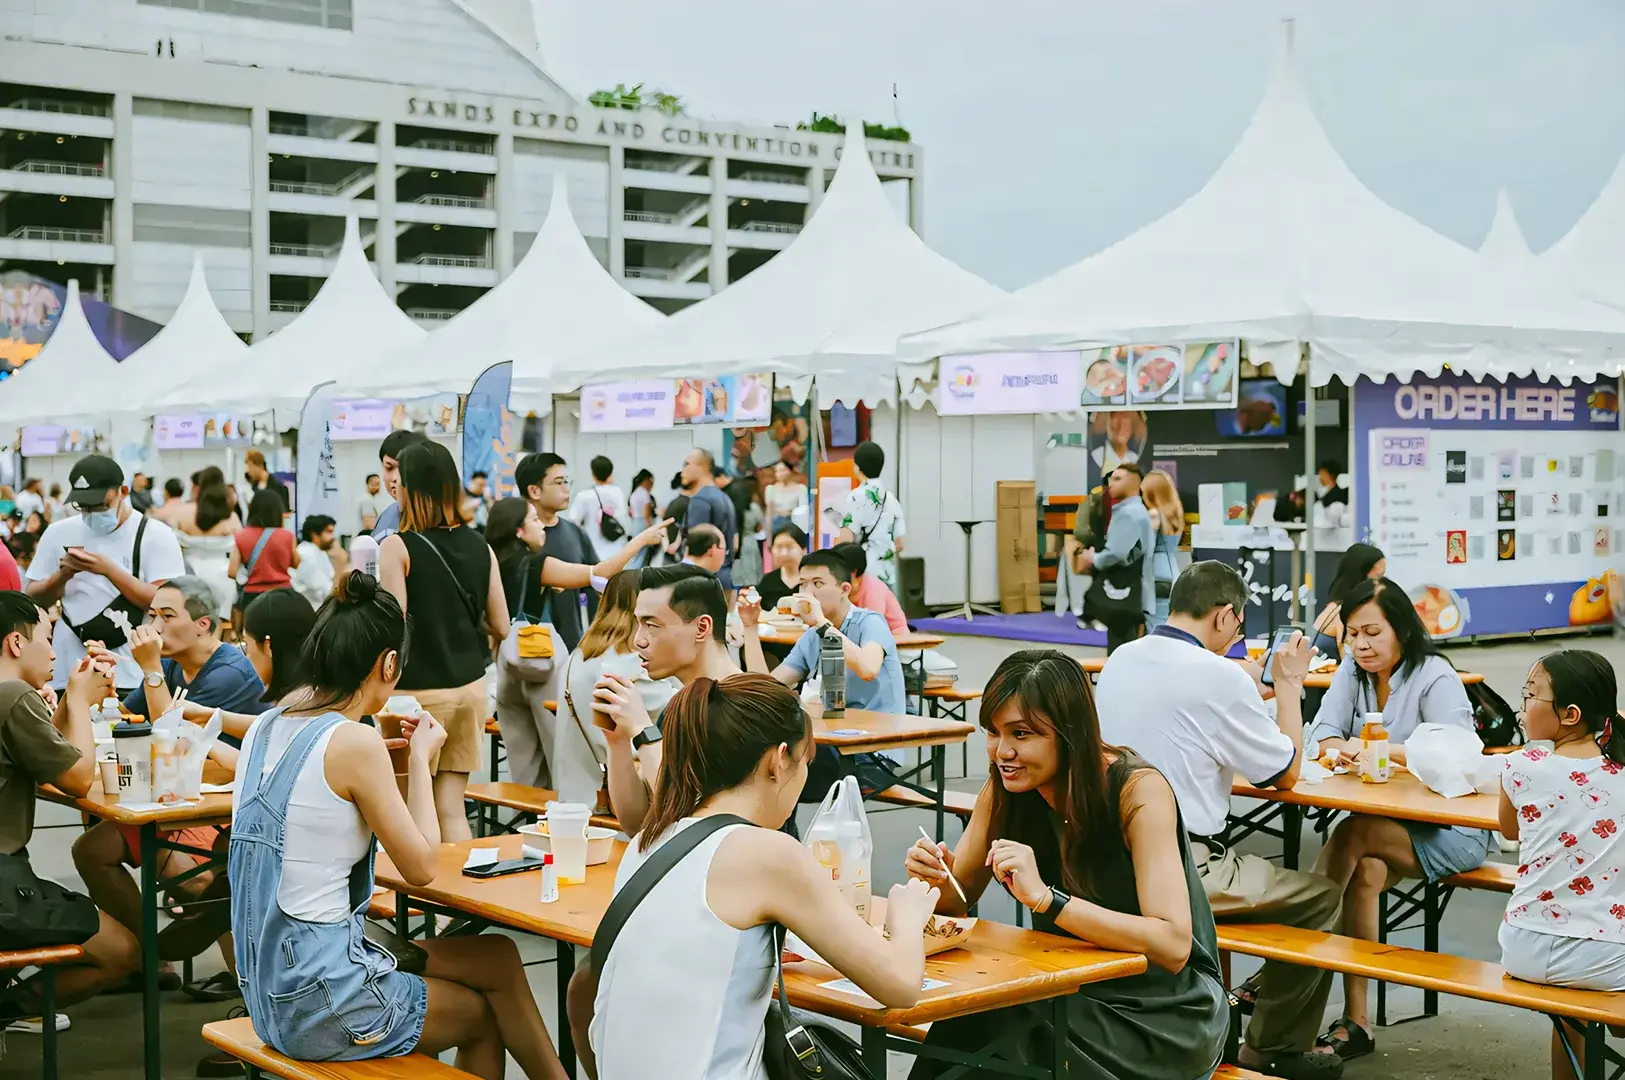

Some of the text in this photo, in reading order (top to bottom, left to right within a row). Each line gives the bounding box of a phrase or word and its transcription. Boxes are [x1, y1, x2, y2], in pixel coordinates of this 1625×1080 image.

[408, 97, 495, 123] SANDS
[513, 109, 579, 132] EXPO
[597, 119, 645, 139] AND
[662, 127, 819, 158] CONVENTION
[1394, 385, 1576, 422] ORDER HERE
